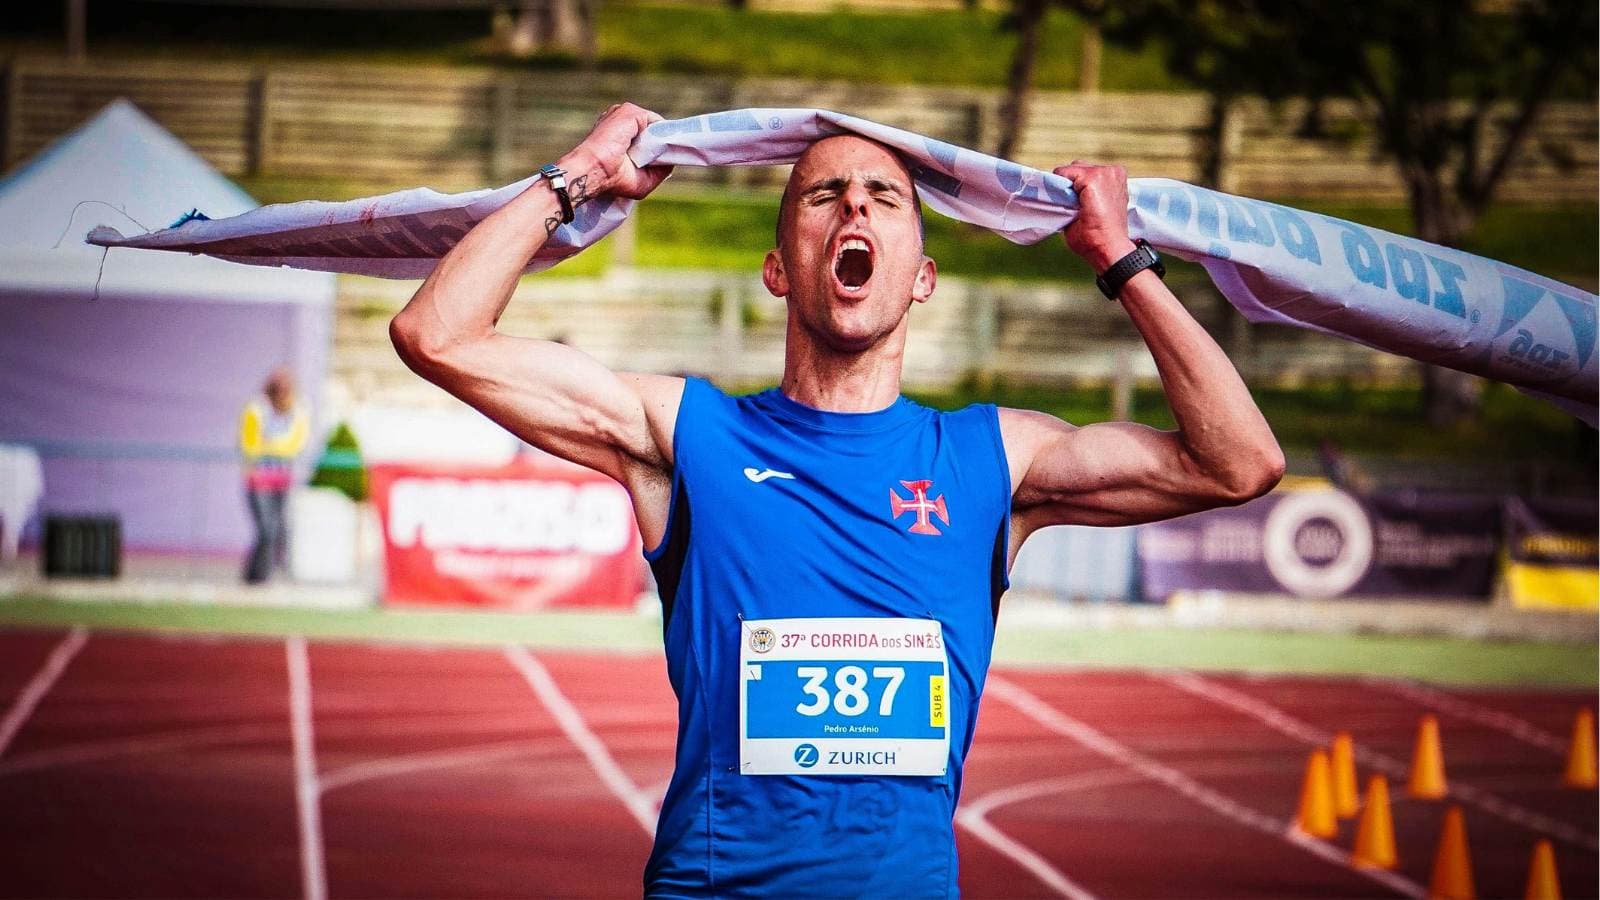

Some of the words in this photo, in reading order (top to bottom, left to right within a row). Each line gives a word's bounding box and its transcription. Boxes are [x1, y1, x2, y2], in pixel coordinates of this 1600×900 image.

[810, 633, 879, 648] CORRIDA
[796, 666, 905, 716] 387
[933, 695, 942, 718] SUB
[824, 724, 848, 734] Pedro
[848, 724, 879, 734] Arsénio
[828, 751, 896, 765] ZURICH
